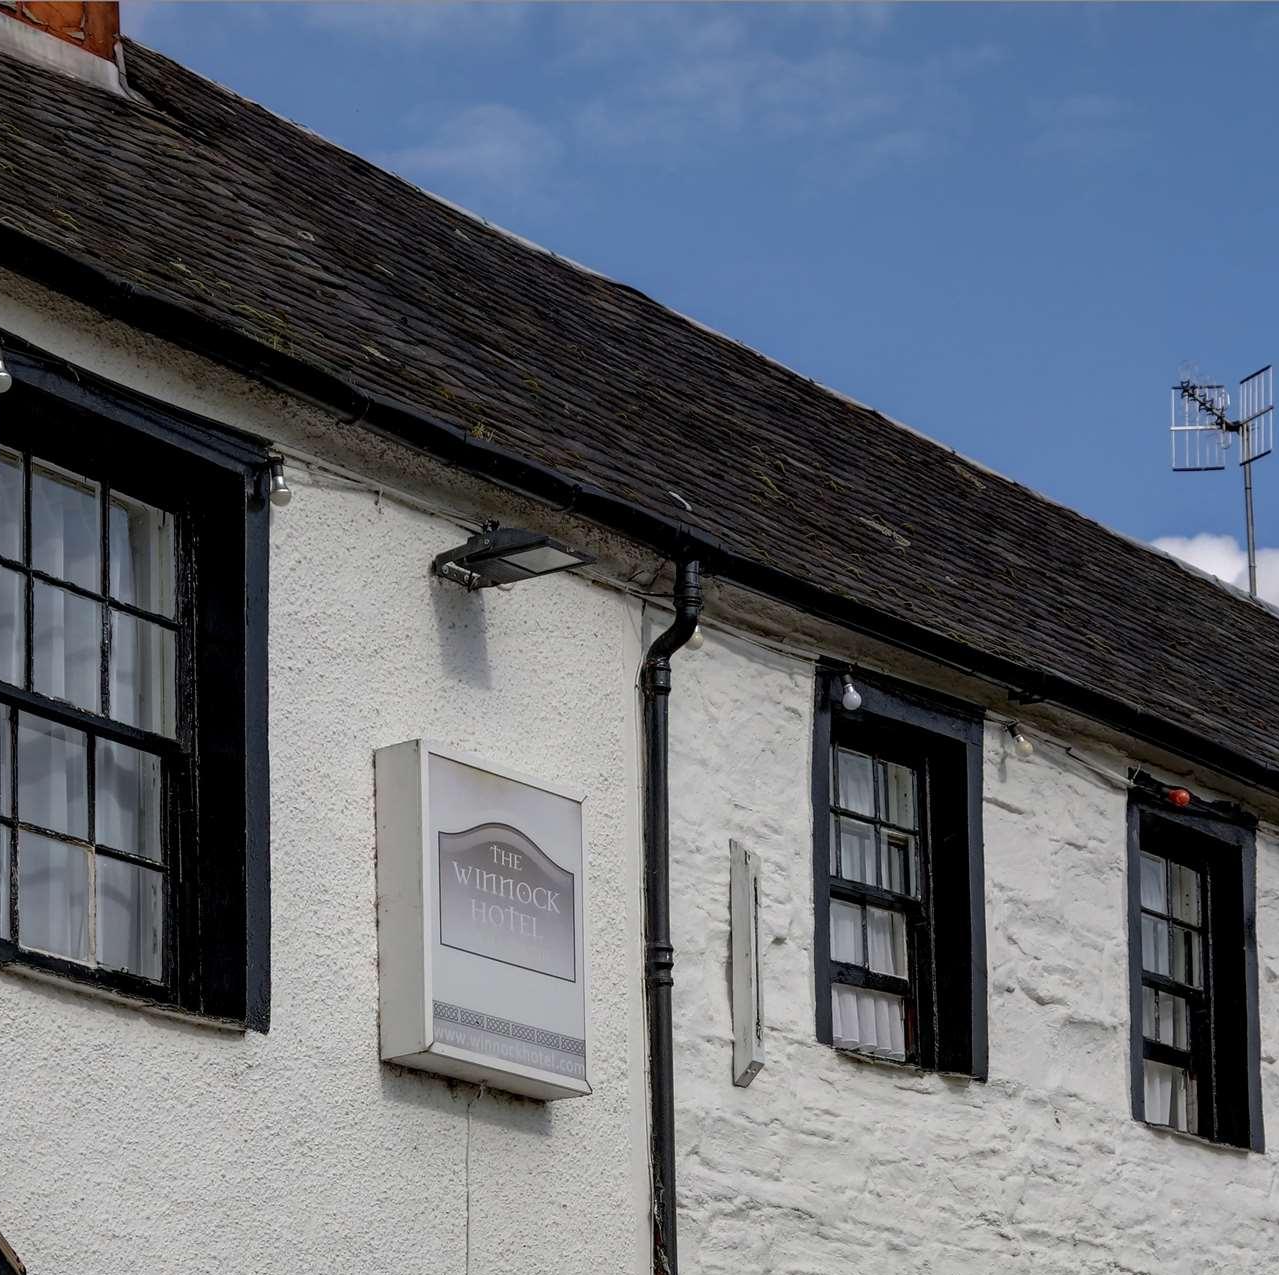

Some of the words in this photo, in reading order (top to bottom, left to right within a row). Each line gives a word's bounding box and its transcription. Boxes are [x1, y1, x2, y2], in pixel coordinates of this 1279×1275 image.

[489, 844, 522, 871] THE
[451, 861, 561, 914] WINNOCK
[471, 899, 543, 938] HOTEL
